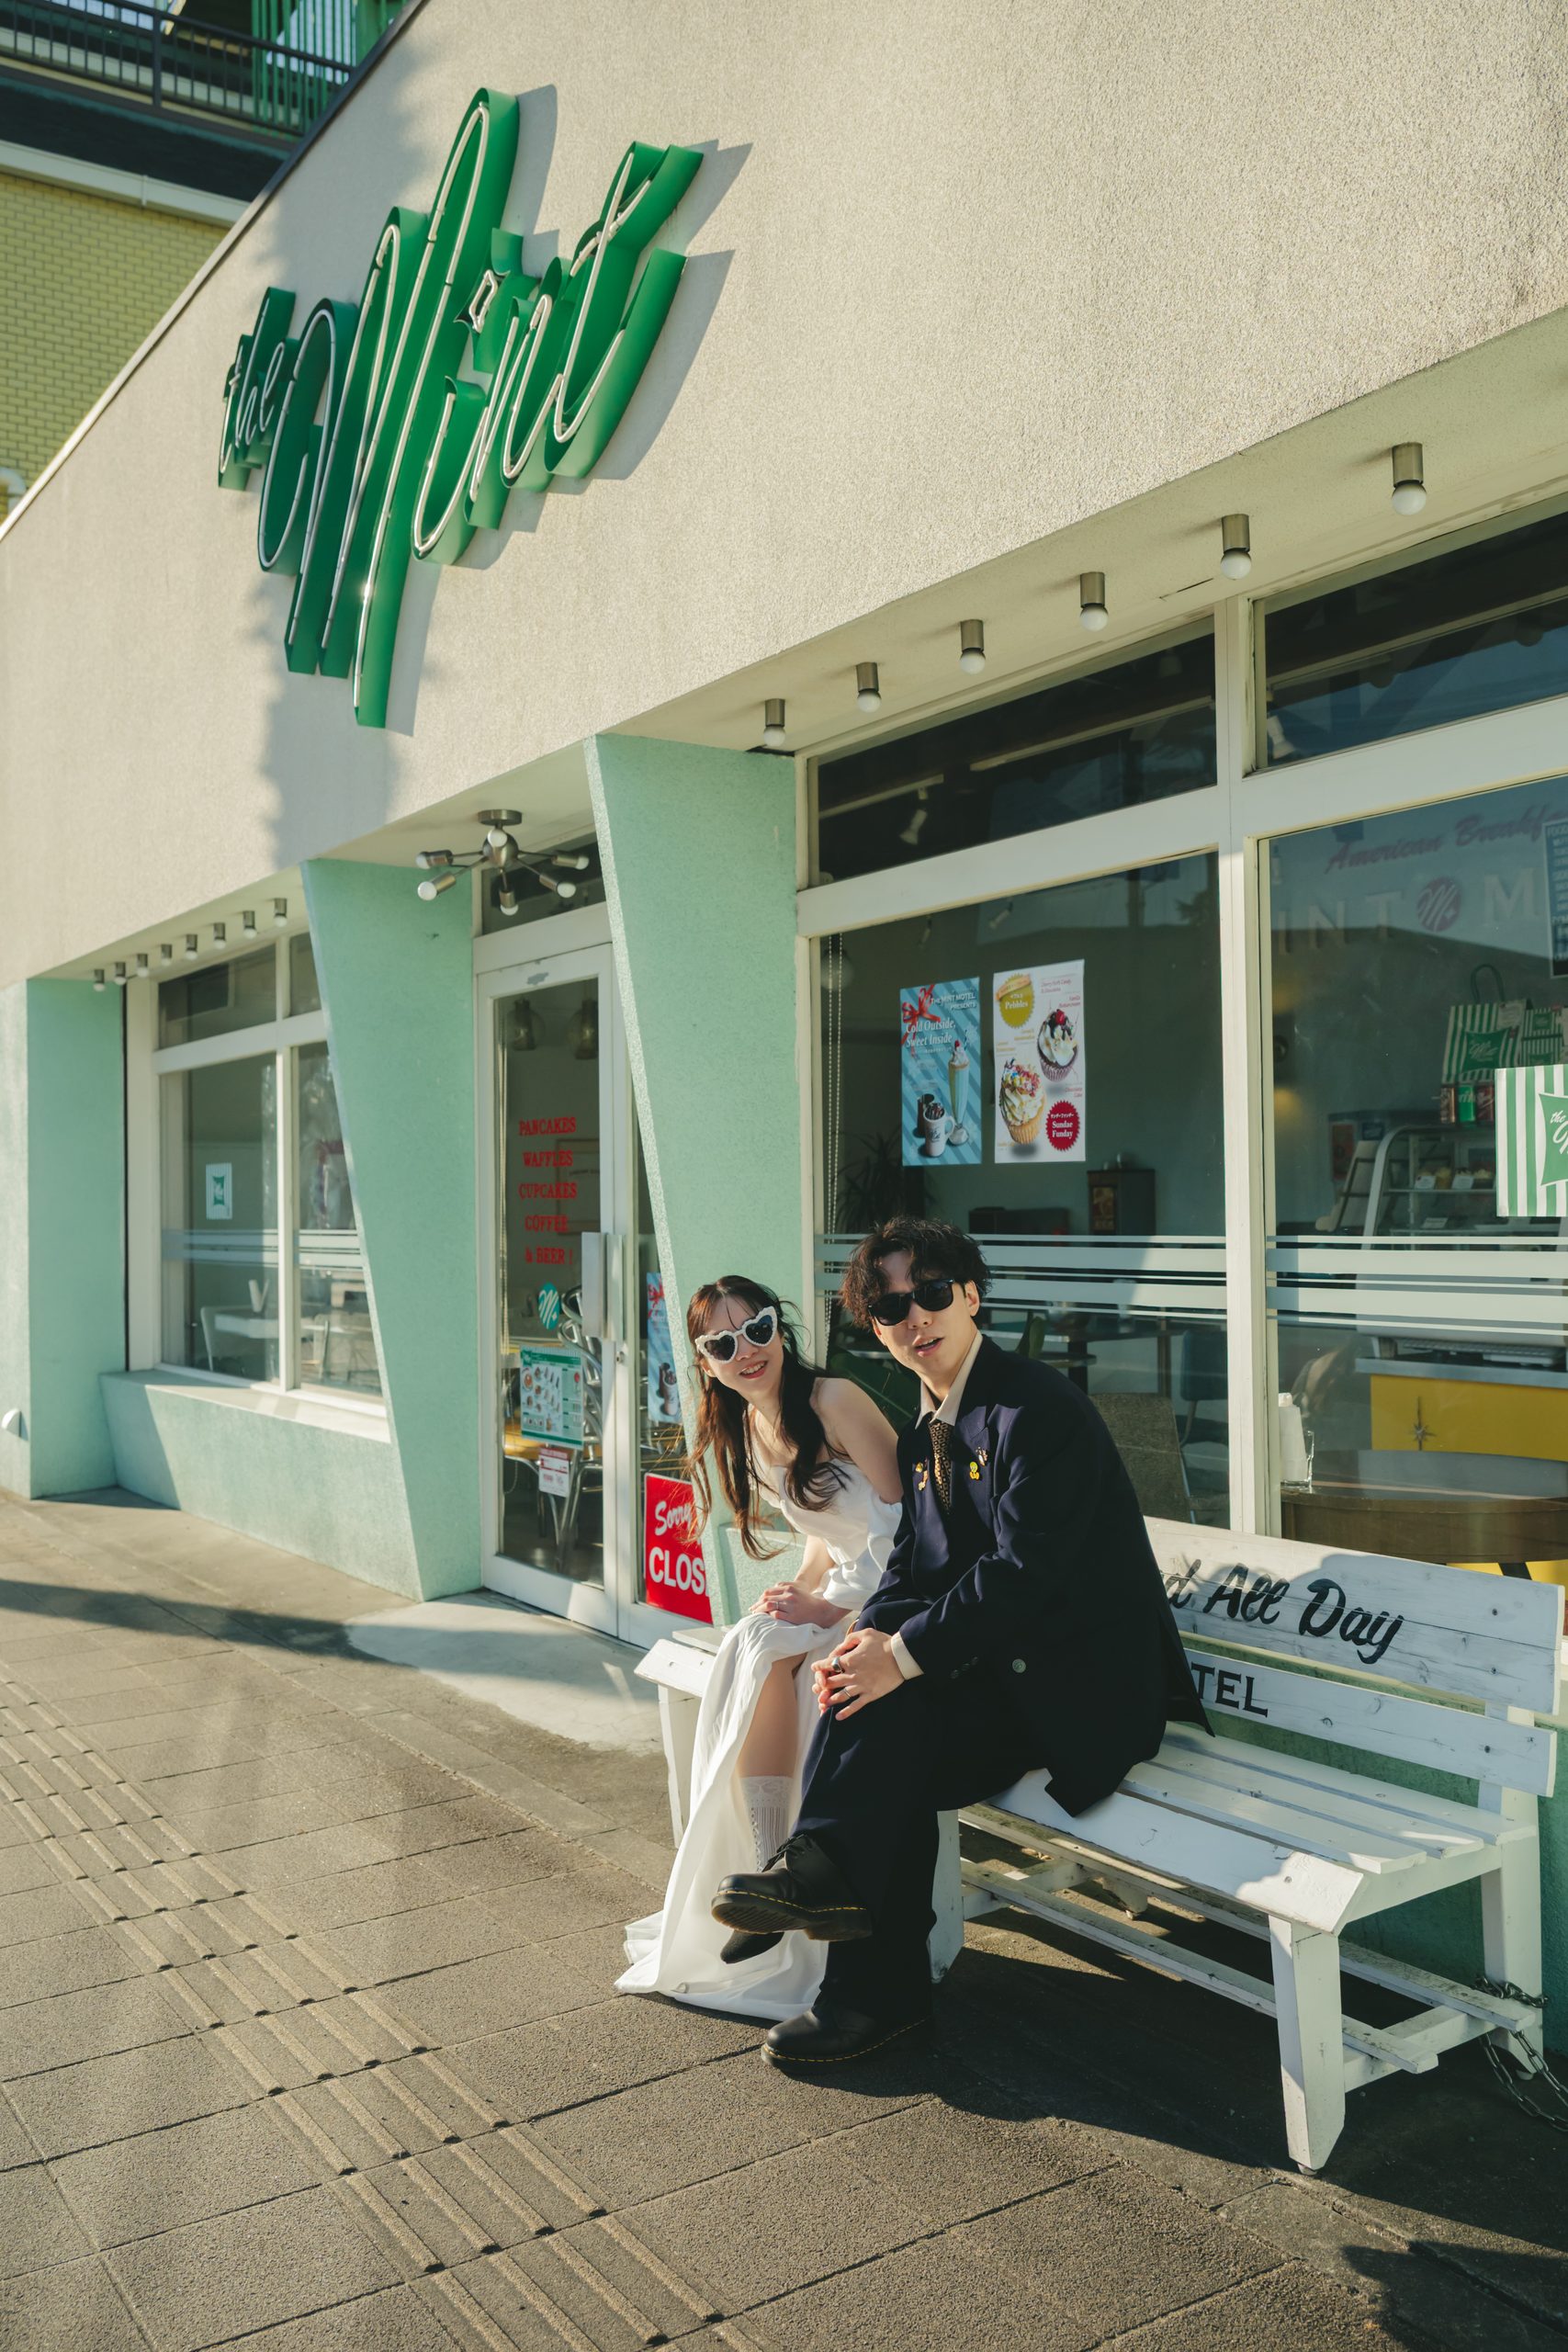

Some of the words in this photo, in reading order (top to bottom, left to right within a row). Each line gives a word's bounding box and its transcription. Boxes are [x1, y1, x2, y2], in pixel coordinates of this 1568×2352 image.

[258, 87, 705, 729] Mint
[1325, 835, 1444, 874] American
[955, 992, 976, 1001] MOTEL
[1005, 1000, 1029, 1011] Pebbles
[906, 1021, 923, 1034] Cold
[906, 1036, 928, 1047] Sweet
[930, 1033, 953, 1045] Inside
[519, 1116, 576, 1136] PANCAKES
[1052, 1120, 1074, 1129] Sundae
[1052, 1129, 1074, 1139] Funday
[523, 1150, 573, 1168] WAFFLES
[518, 1182, 577, 1199] CUPCAKES
[525, 1215, 569, 1232] COFFEE
[536, 1248, 565, 1264] BEER
[649, 1546, 710, 1598] CLOS
[1203, 1563, 1290, 1624] All
[1299, 1577, 1404, 1664] Day
